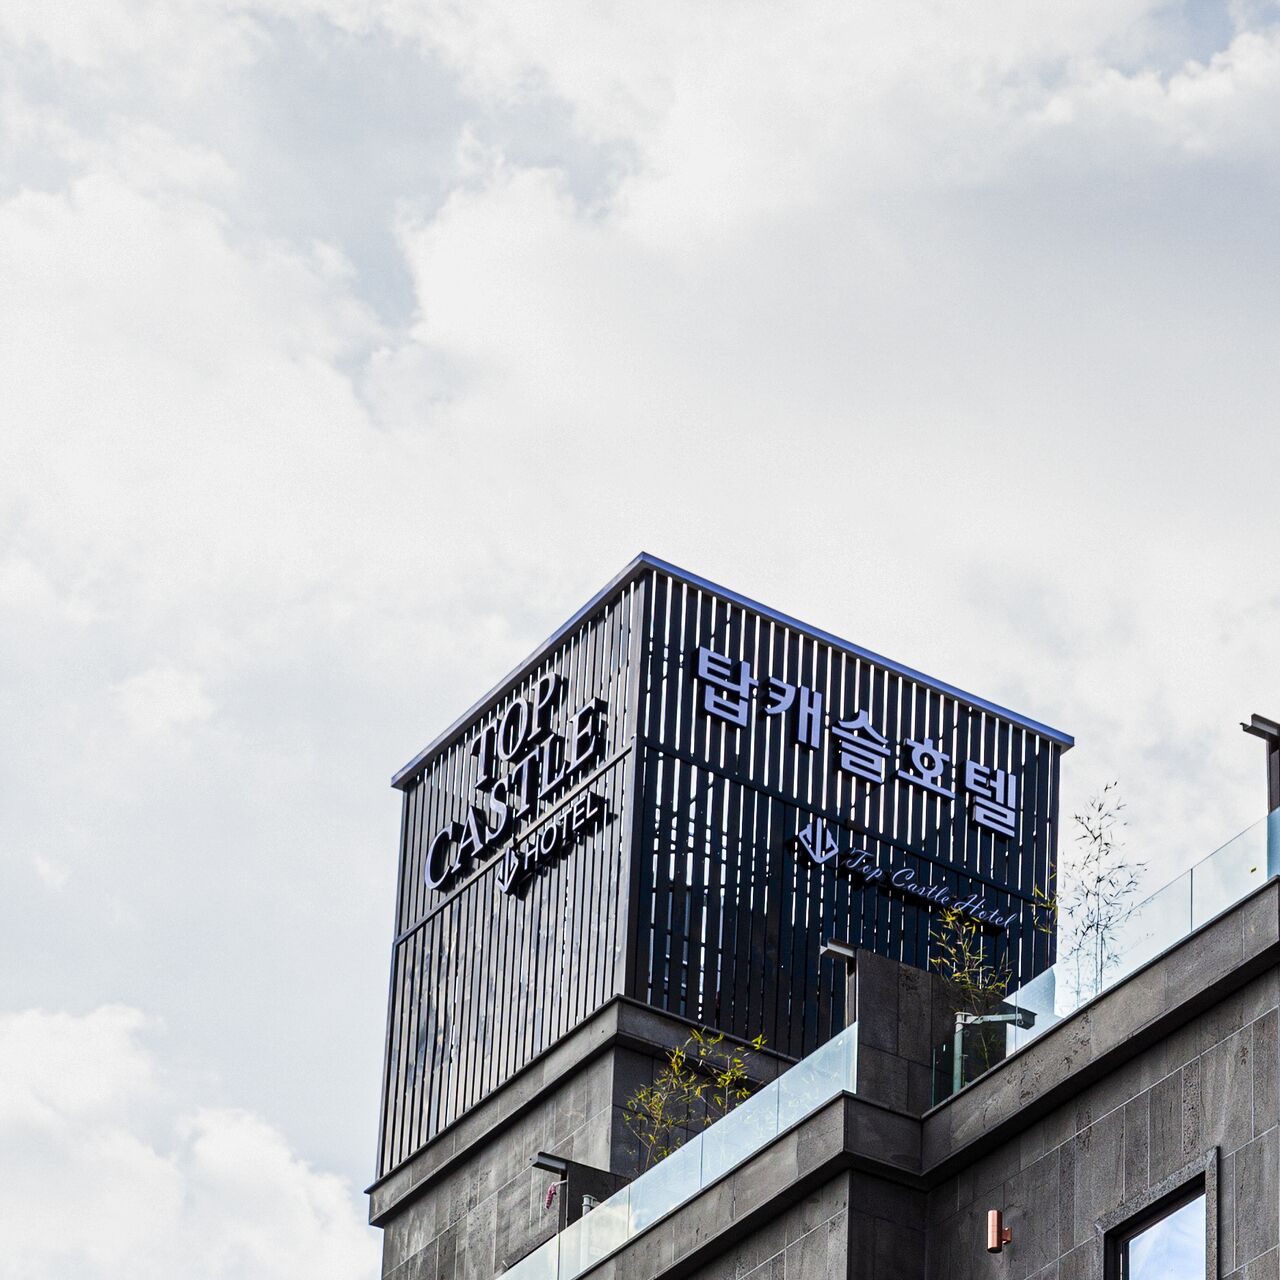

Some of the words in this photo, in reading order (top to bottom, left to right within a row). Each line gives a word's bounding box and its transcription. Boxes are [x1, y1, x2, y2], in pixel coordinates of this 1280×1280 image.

[471, 672, 556, 788] TOP
[699, 646, 1017, 838] 탑캐슬호텔
[425, 697, 597, 890] CASTLE
[524, 791, 598, 870] HOTEL
[846, 848, 883, 881] Top
[891, 868, 950, 905] Castle
[950, 894, 1018, 928] Hotel
